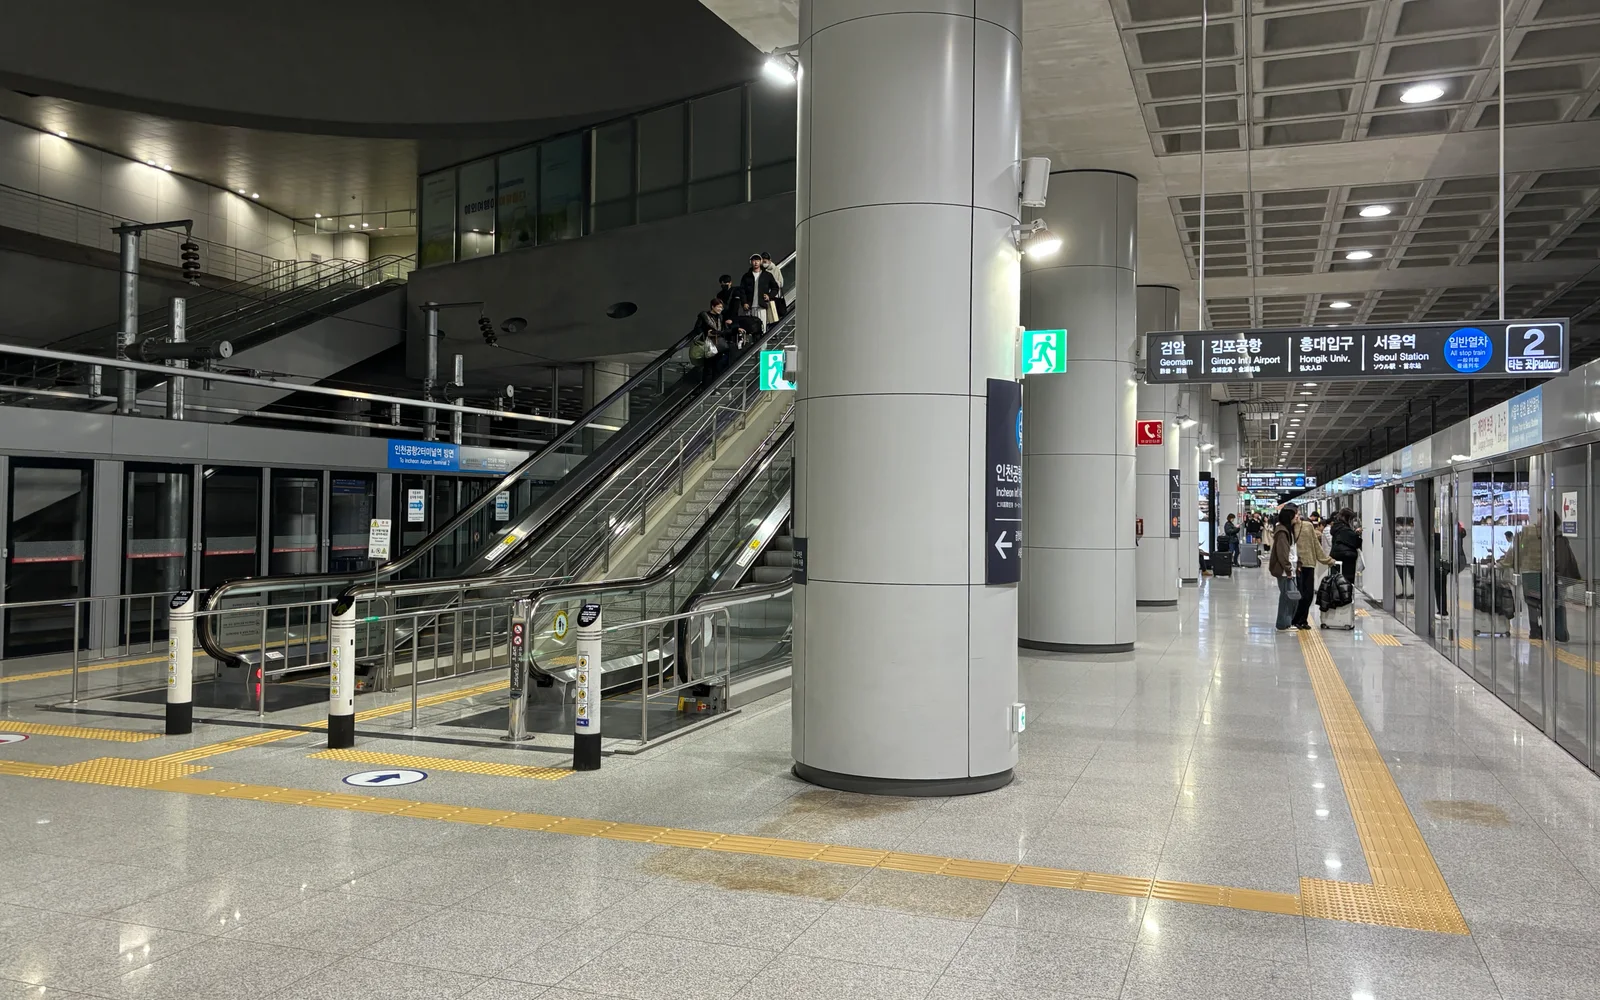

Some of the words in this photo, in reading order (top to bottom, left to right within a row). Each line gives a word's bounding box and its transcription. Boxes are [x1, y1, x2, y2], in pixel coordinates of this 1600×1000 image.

[1161, 340, 1186, 355] 검암
[1211, 338, 1262, 354] 김포공항
[1300, 336, 1354, 352] 홍대입구
[1374, 334, 1416, 350] 서울역
[1449, 336, 1488, 348] 일반열차
[1523, 328, 1545, 356] 2
[1211, 357, 1236, 366] Gimpo
[1253, 356, 1280, 366] Airport
[1300, 355, 1328, 364] Hongik
[1330, 354, 1350, 362] Univ.
[1374, 353, 1397, 362] Seoul
[1400, 352, 1430, 360] Station
[1508, 360, 1524, 370] 타는
[1525, 359, 1533, 370] 곳
[1534, 360, 1560, 370] Platform
[394, 445, 442, 458] 인천공항2터미널역
[996, 464, 1021, 483] 인천공
